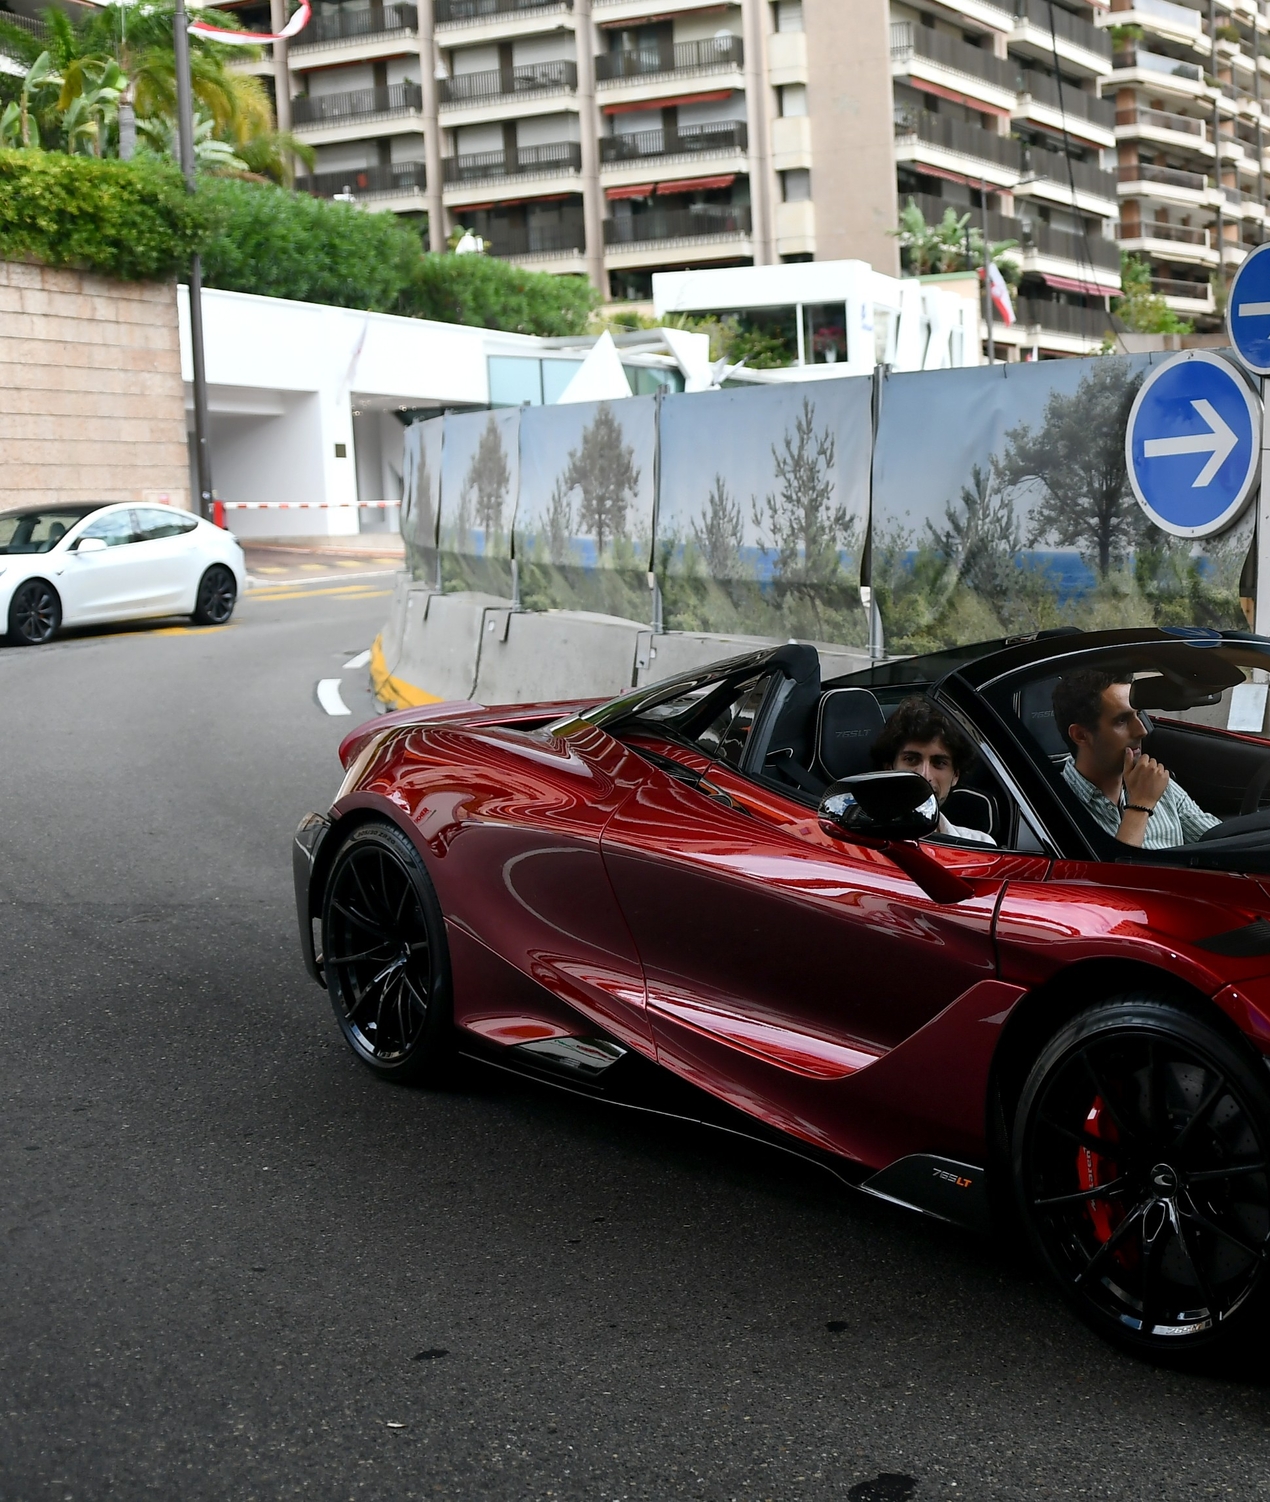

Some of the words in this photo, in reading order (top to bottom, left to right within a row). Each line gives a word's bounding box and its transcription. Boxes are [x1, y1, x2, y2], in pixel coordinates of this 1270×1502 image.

[1031, 710, 1055, 719] 765L
[835, 728, 872, 738] 765LT
[932, 1168, 972, 1187] 765LT
